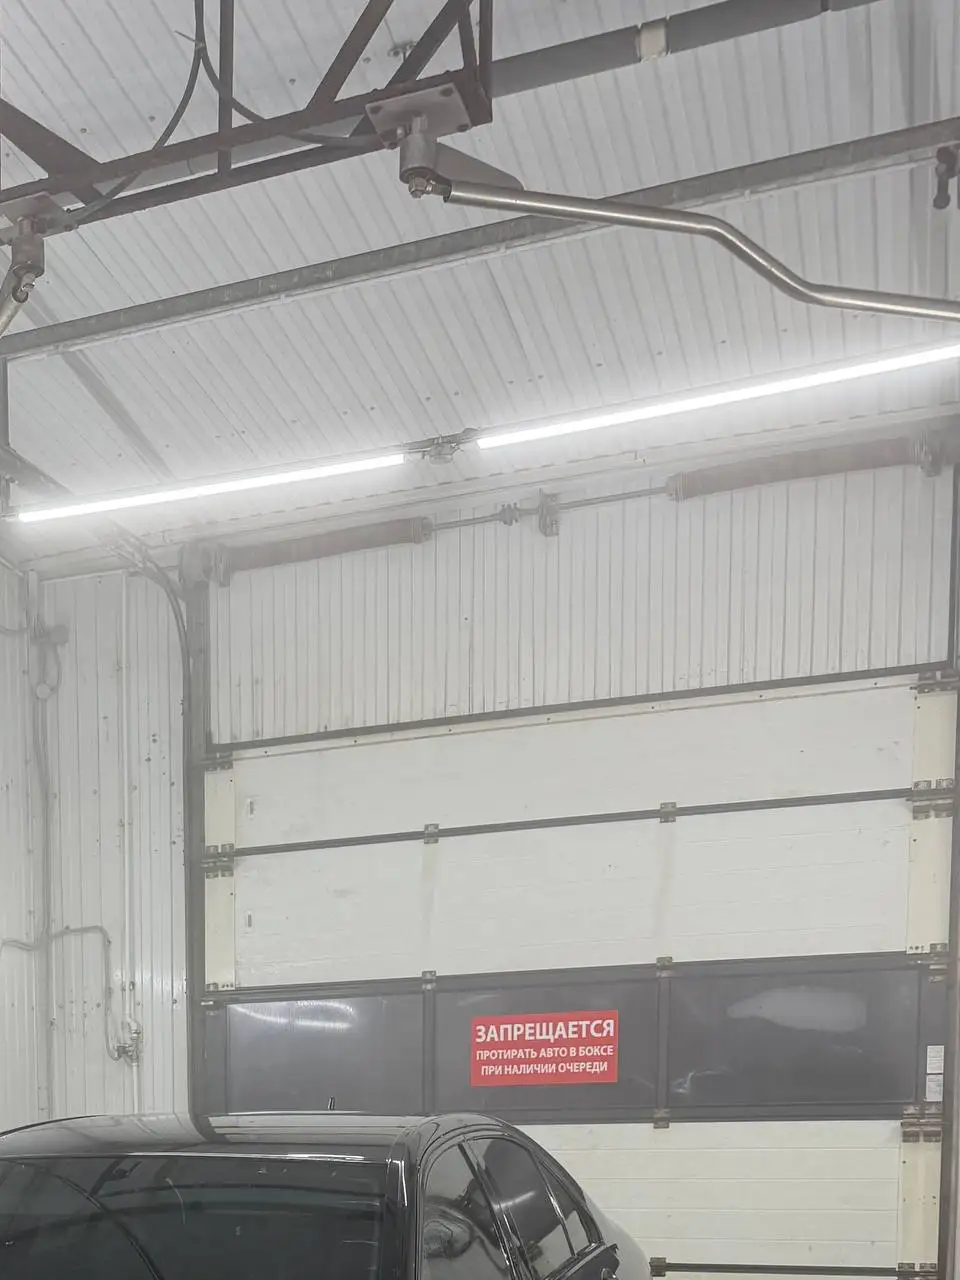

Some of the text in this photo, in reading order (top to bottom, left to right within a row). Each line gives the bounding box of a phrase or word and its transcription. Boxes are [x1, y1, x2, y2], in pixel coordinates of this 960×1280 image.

[475, 1019, 615, 1043] ЗАПРЕЩАЕТСЯ
[476, 1045, 614, 1060] ПРОТИРАТЬ АВТО В БОКСЕ
[481, 1061, 608, 1076] ПРИ НАЛИЧИИ ОЧЕРЕДИ
